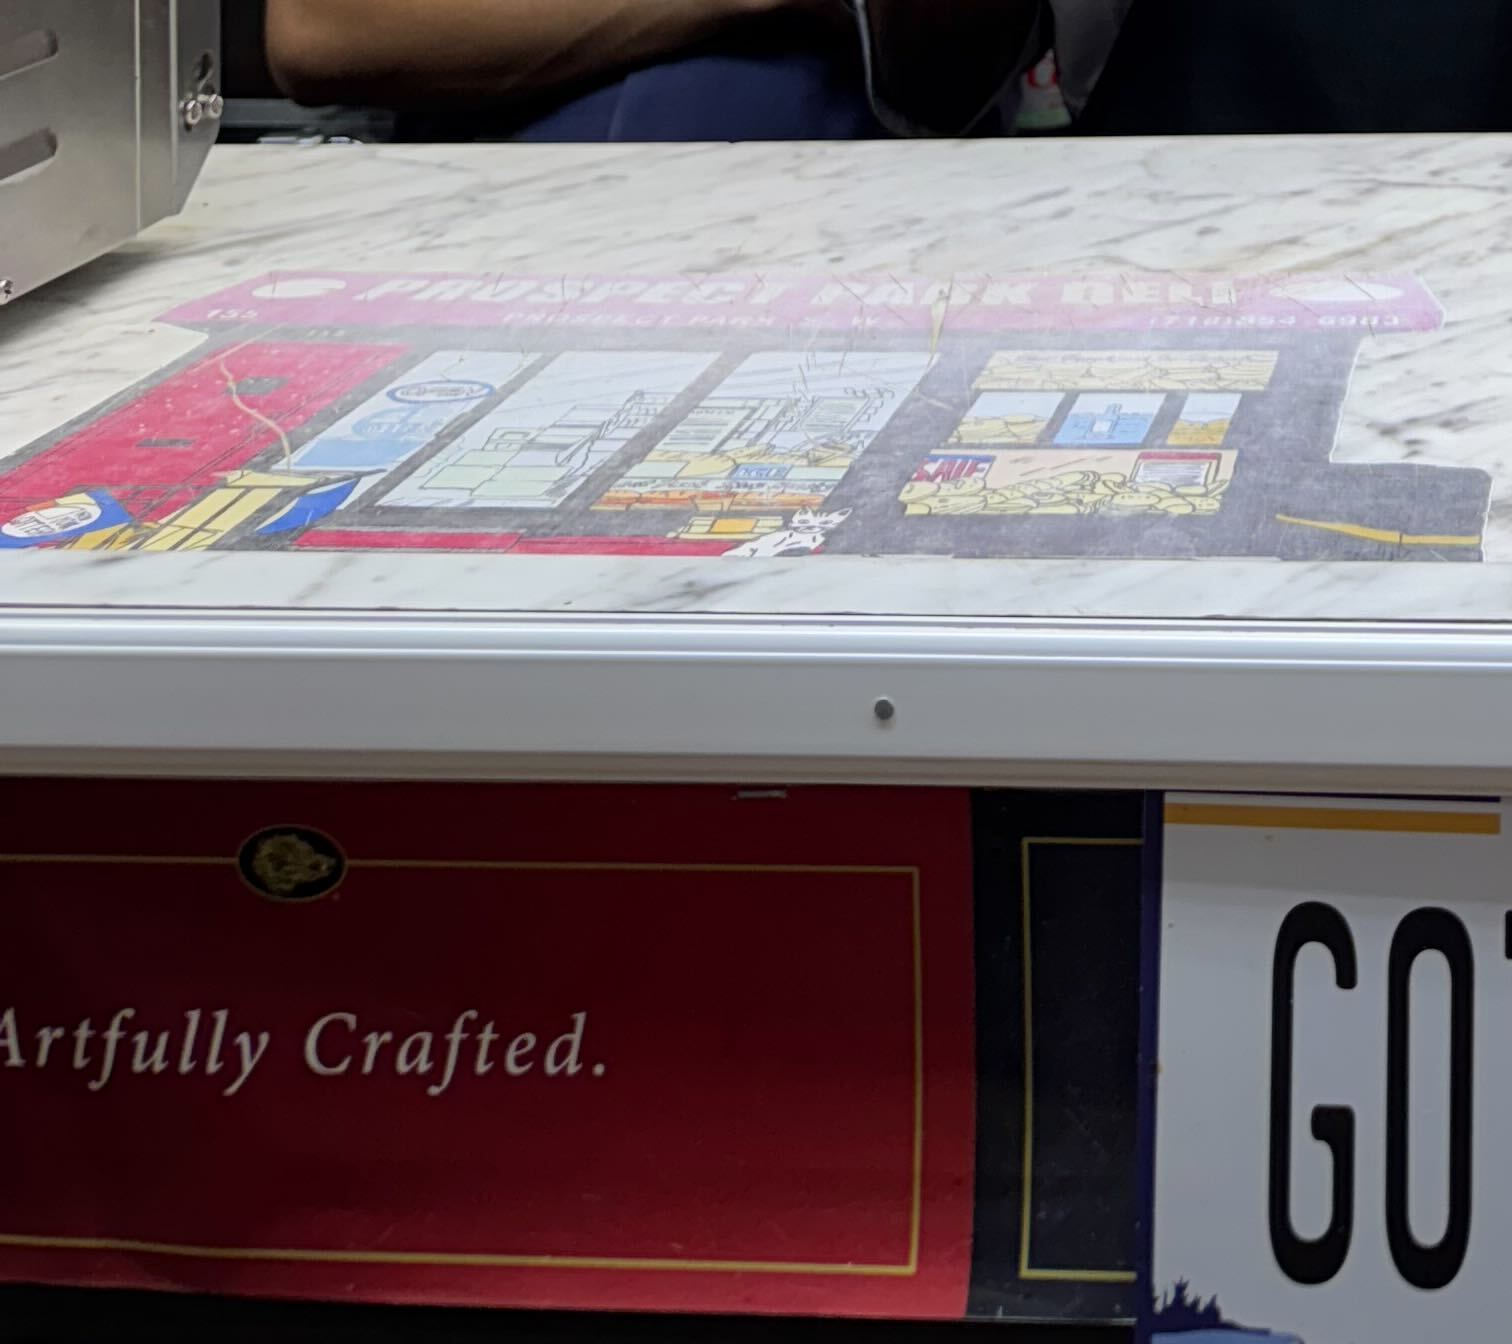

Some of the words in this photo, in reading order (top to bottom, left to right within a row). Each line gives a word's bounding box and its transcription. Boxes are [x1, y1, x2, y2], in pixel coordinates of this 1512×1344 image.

[353, 278, 788, 305] PROSPECT
[809, 280, 1034, 306] PARK
[1061, 280, 1238, 305] DELI
[0, 1006, 271, 1097] Artfully
[304, 1008, 608, 1097] Crafted.
